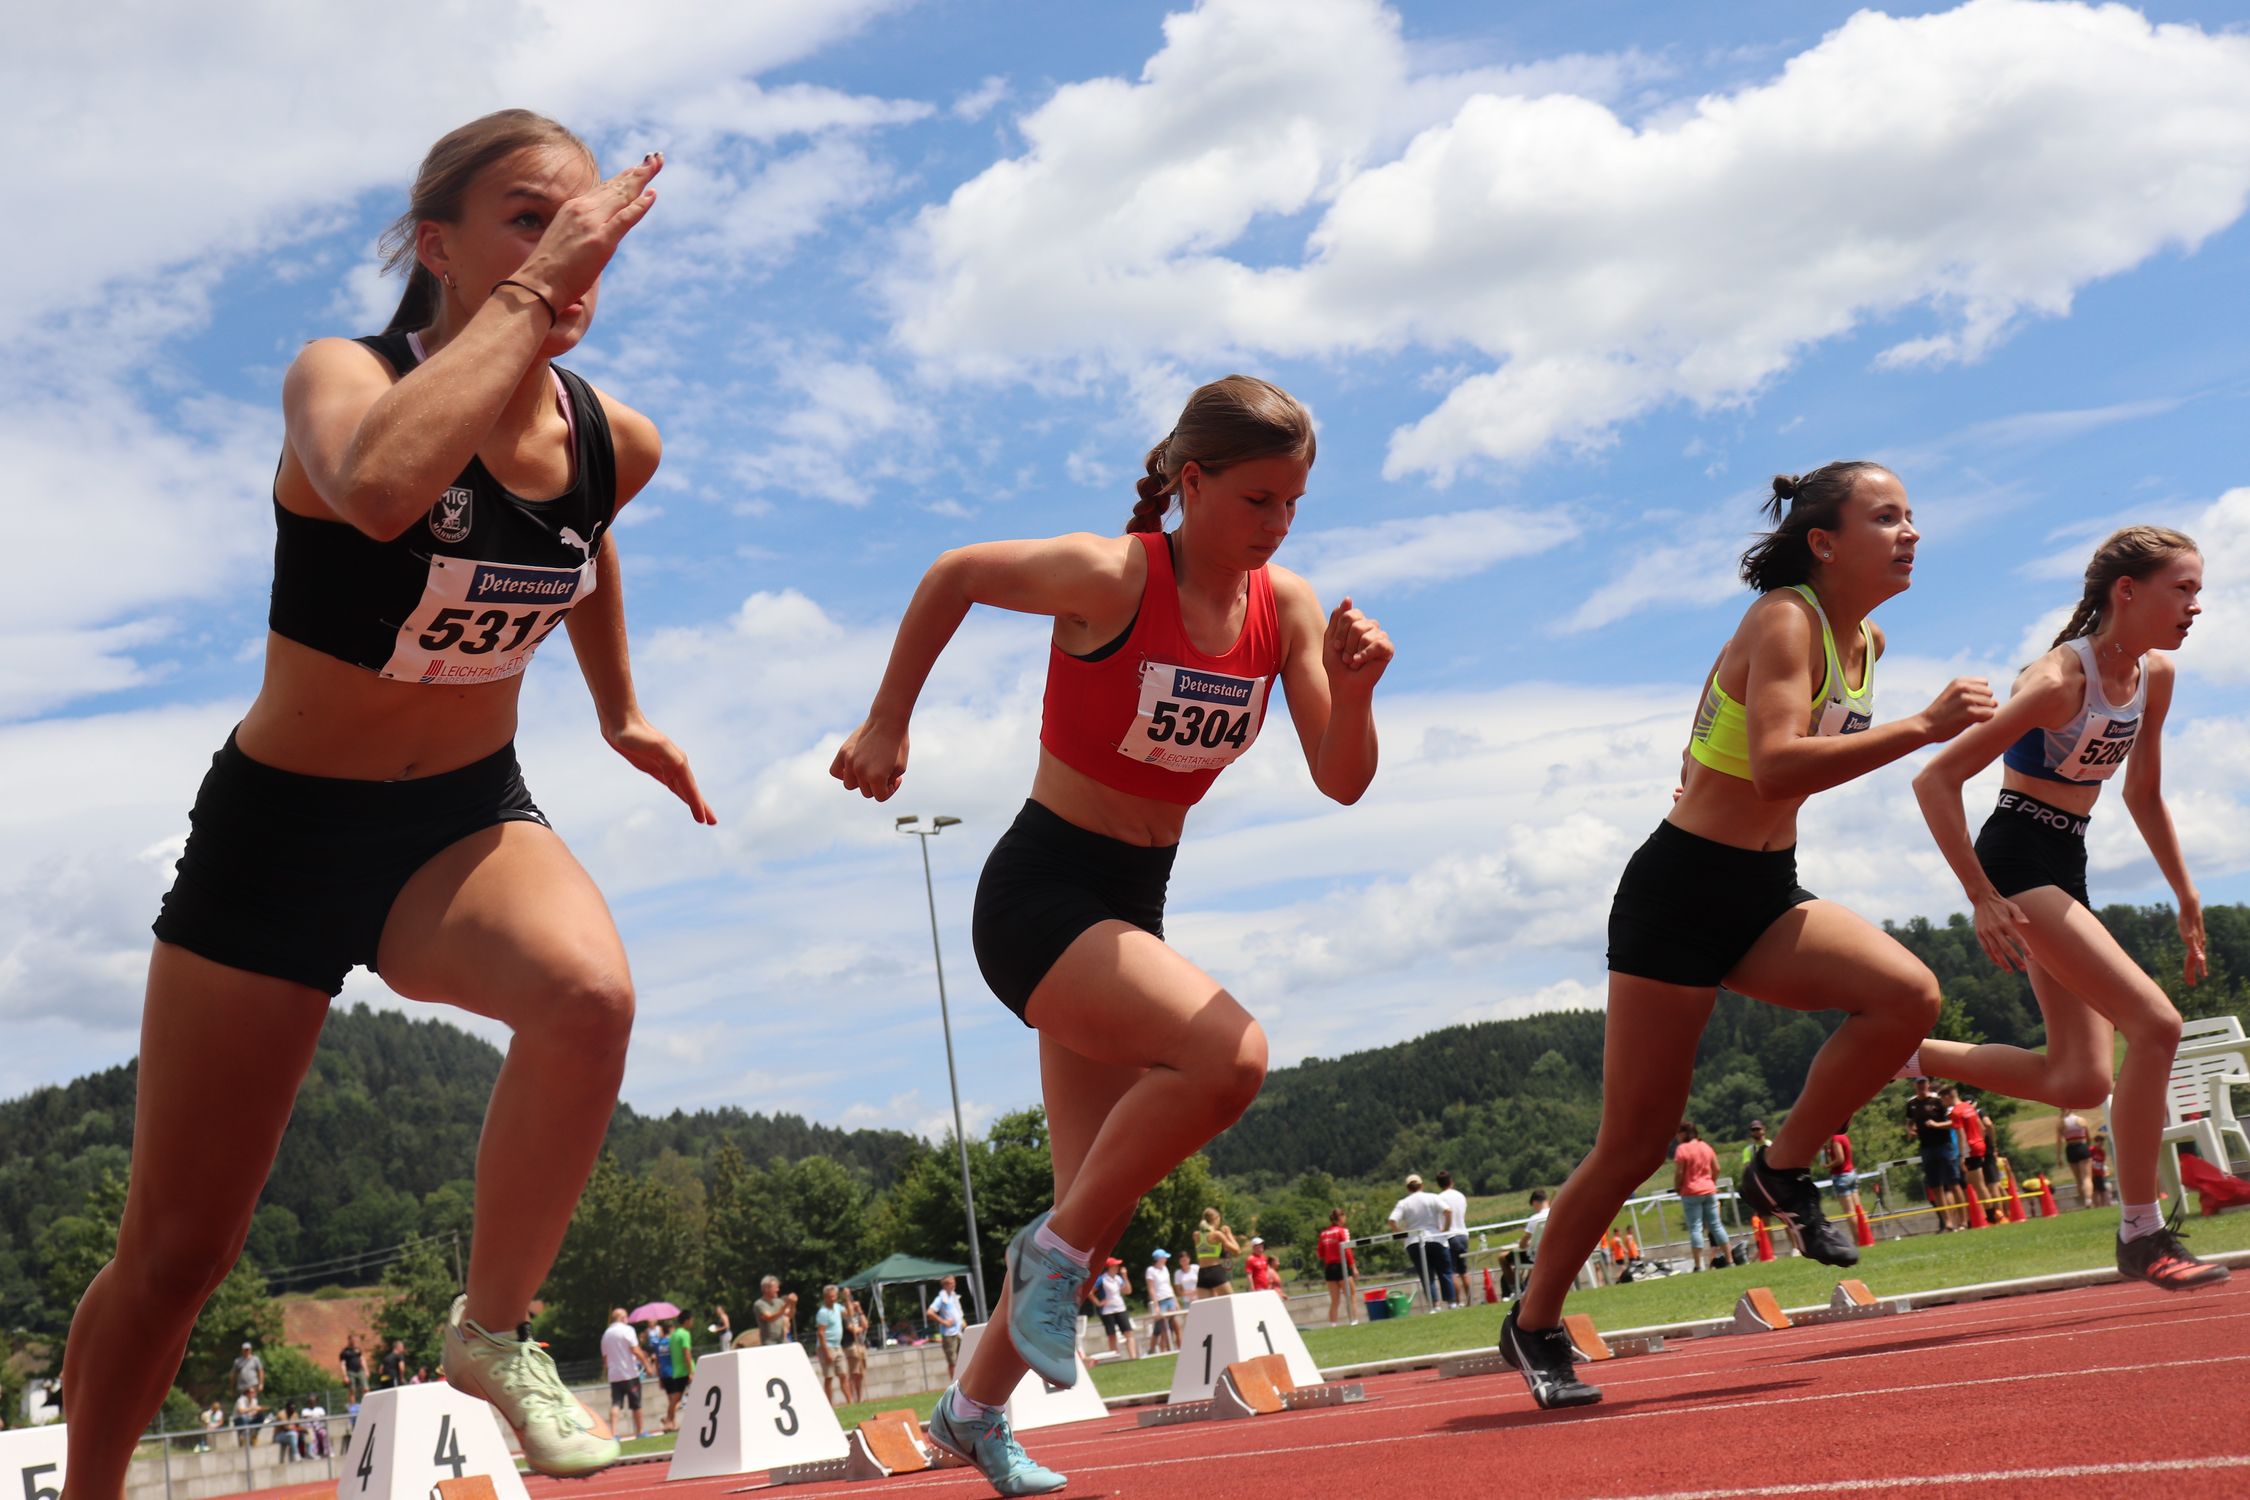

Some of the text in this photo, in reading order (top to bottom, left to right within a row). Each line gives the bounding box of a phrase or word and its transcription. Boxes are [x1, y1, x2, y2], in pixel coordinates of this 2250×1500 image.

[478, 572, 574, 596] Peterstaler
[1179, 675, 1249, 698] Peterstaler
[1147, 701, 1251, 749] 5304
[2079, 738, 2134, 765] 5282
[2016, 800, 2069, 830] PRO
[1202, 1334, 1213, 1385] 1
[700, 1385, 722, 1448] 3
[766, 1377, 799, 1437] 3
[356, 1423, 376, 1492] 4
[433, 1414, 467, 1478] 4
